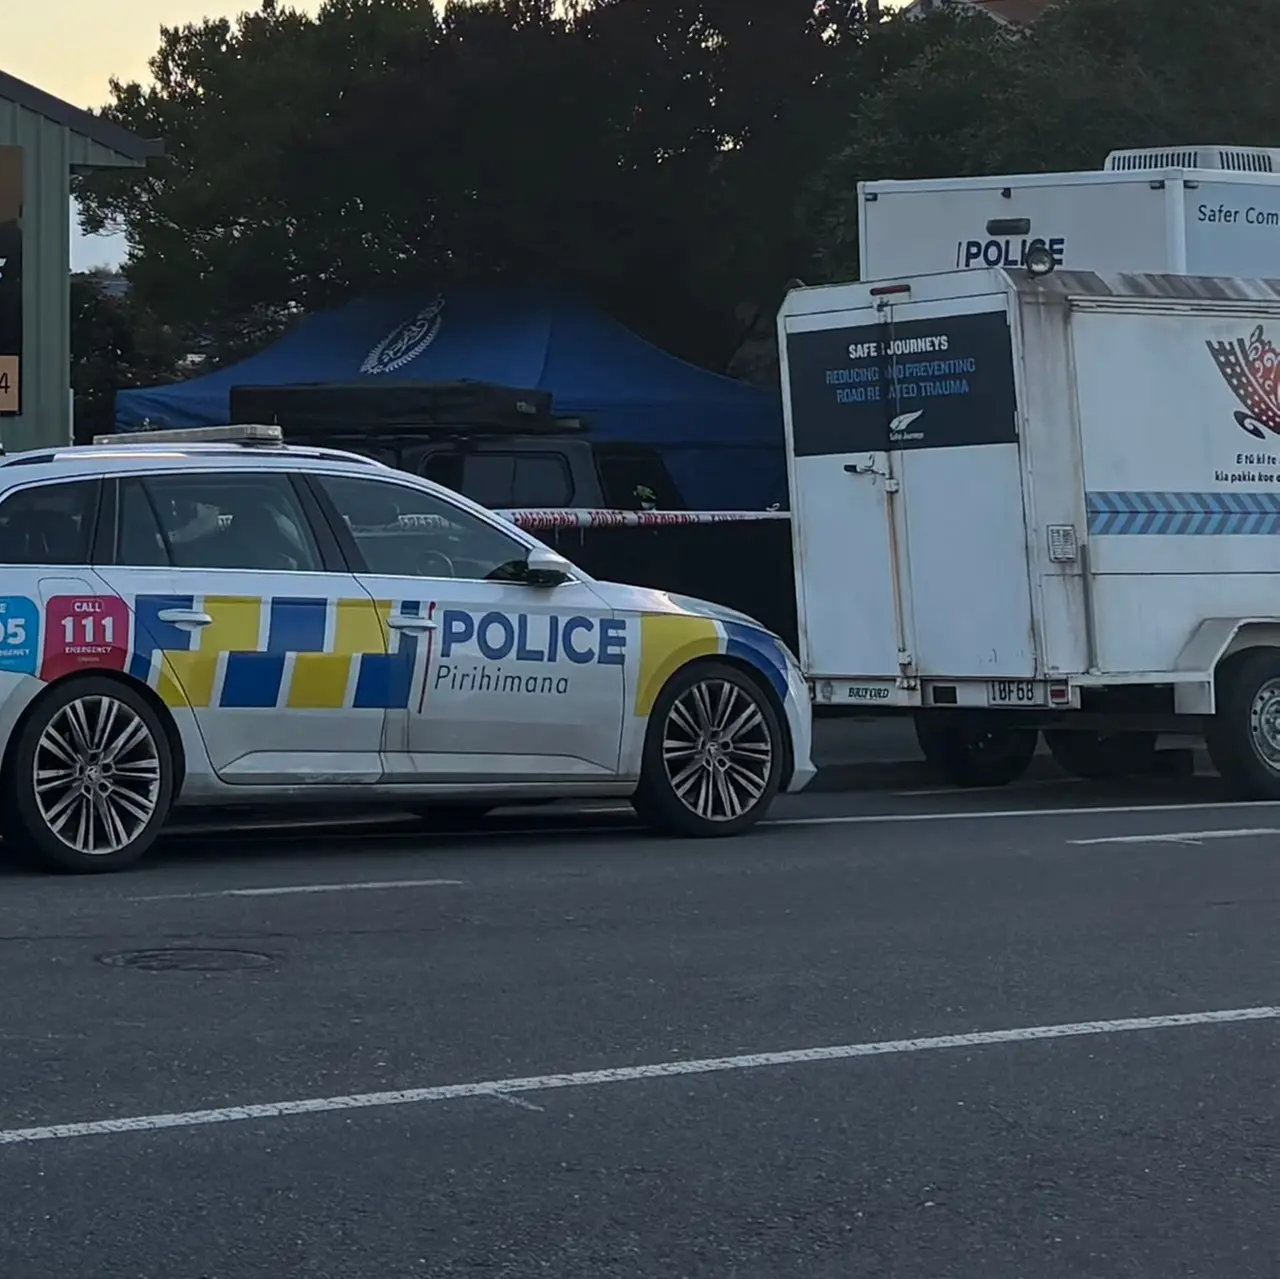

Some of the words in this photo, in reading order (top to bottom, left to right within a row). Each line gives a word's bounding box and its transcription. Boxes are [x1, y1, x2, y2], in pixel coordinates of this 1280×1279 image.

[1198, 204, 1240, 222] Safer
[1245, 207, 1279, 225] Com
[848, 342, 879, 359] SAFE
[886, 335, 949, 355] JOURNEYS
[826, 367, 879, 384] REDUCING
[906, 358, 976, 377] PREVENTING
[836, 389, 867, 404] ROAD
[920, 379, 970, 396] TRAUMA
[1236, 453, 1244, 465] E
[74, 602, 102, 612] CALL
[61, 616, 114, 643] 111
[440, 609, 627, 665] POLICE
[434, 665, 570, 694] Pirihimana
